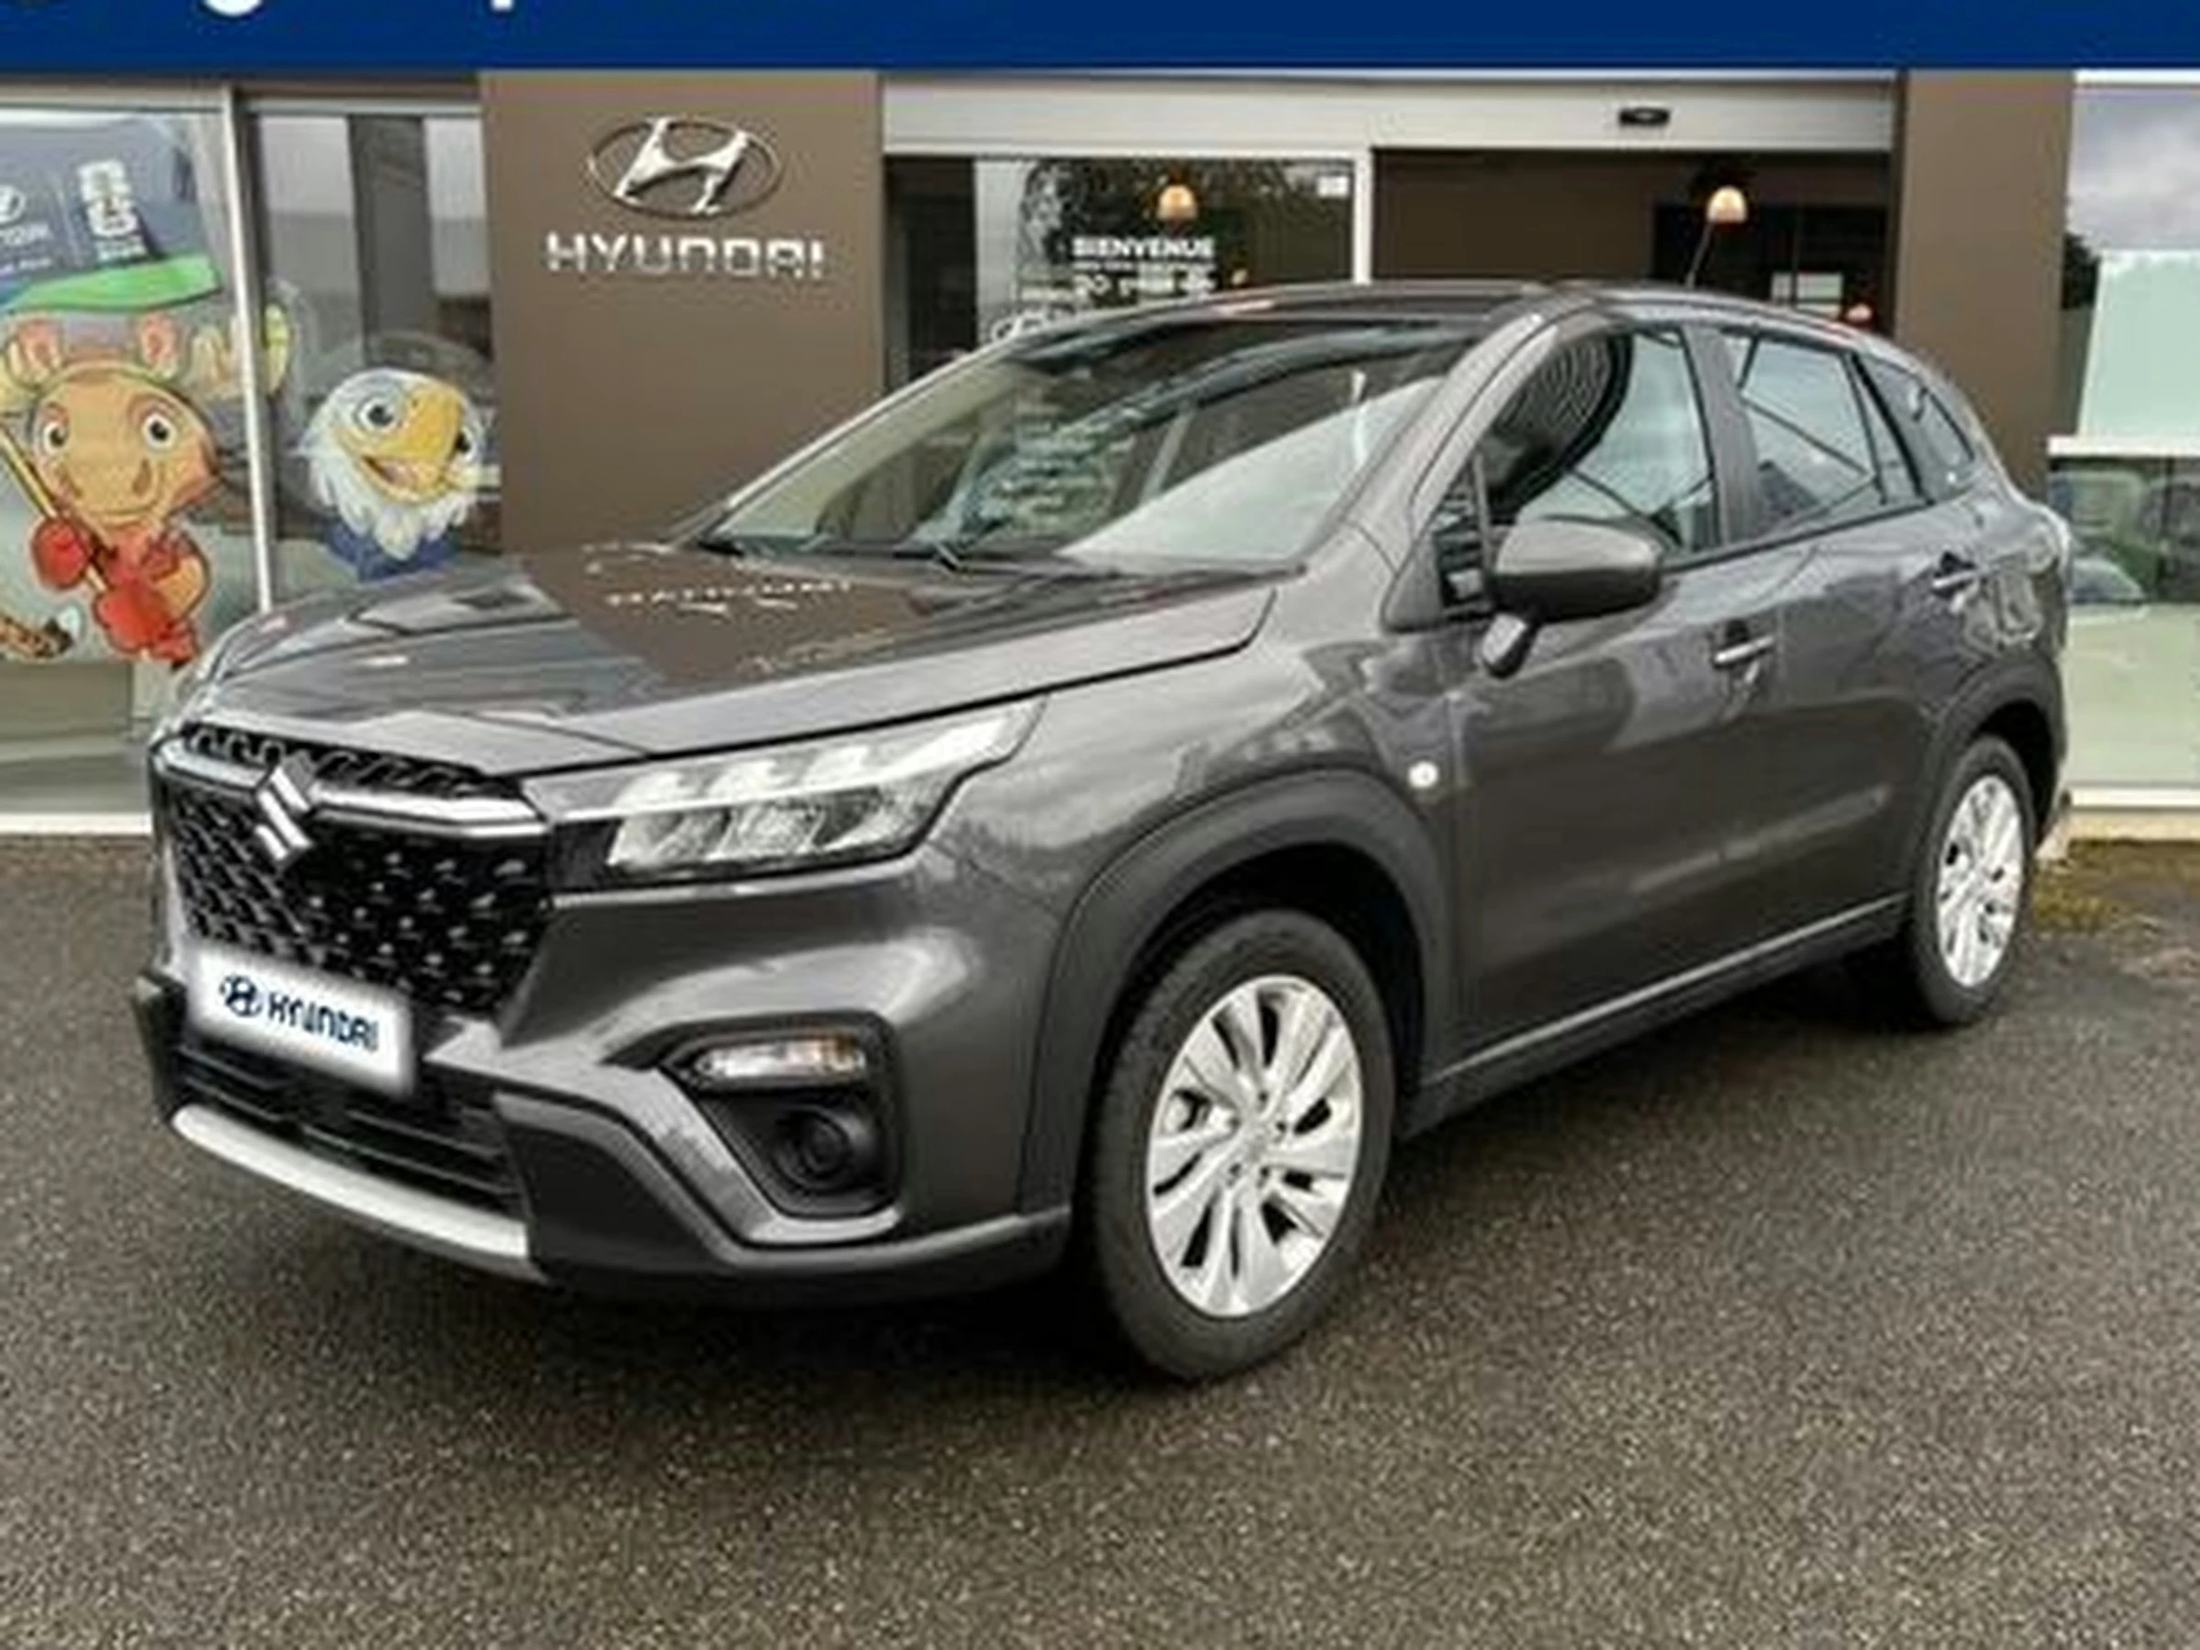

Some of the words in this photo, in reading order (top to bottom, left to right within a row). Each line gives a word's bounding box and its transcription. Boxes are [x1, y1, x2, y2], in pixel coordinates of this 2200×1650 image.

[545, 231, 824, 279] HYUNDAI
[1072, 237, 1215, 257] BIENVENUE
[267, 992, 379, 1053] HYUNDAI
